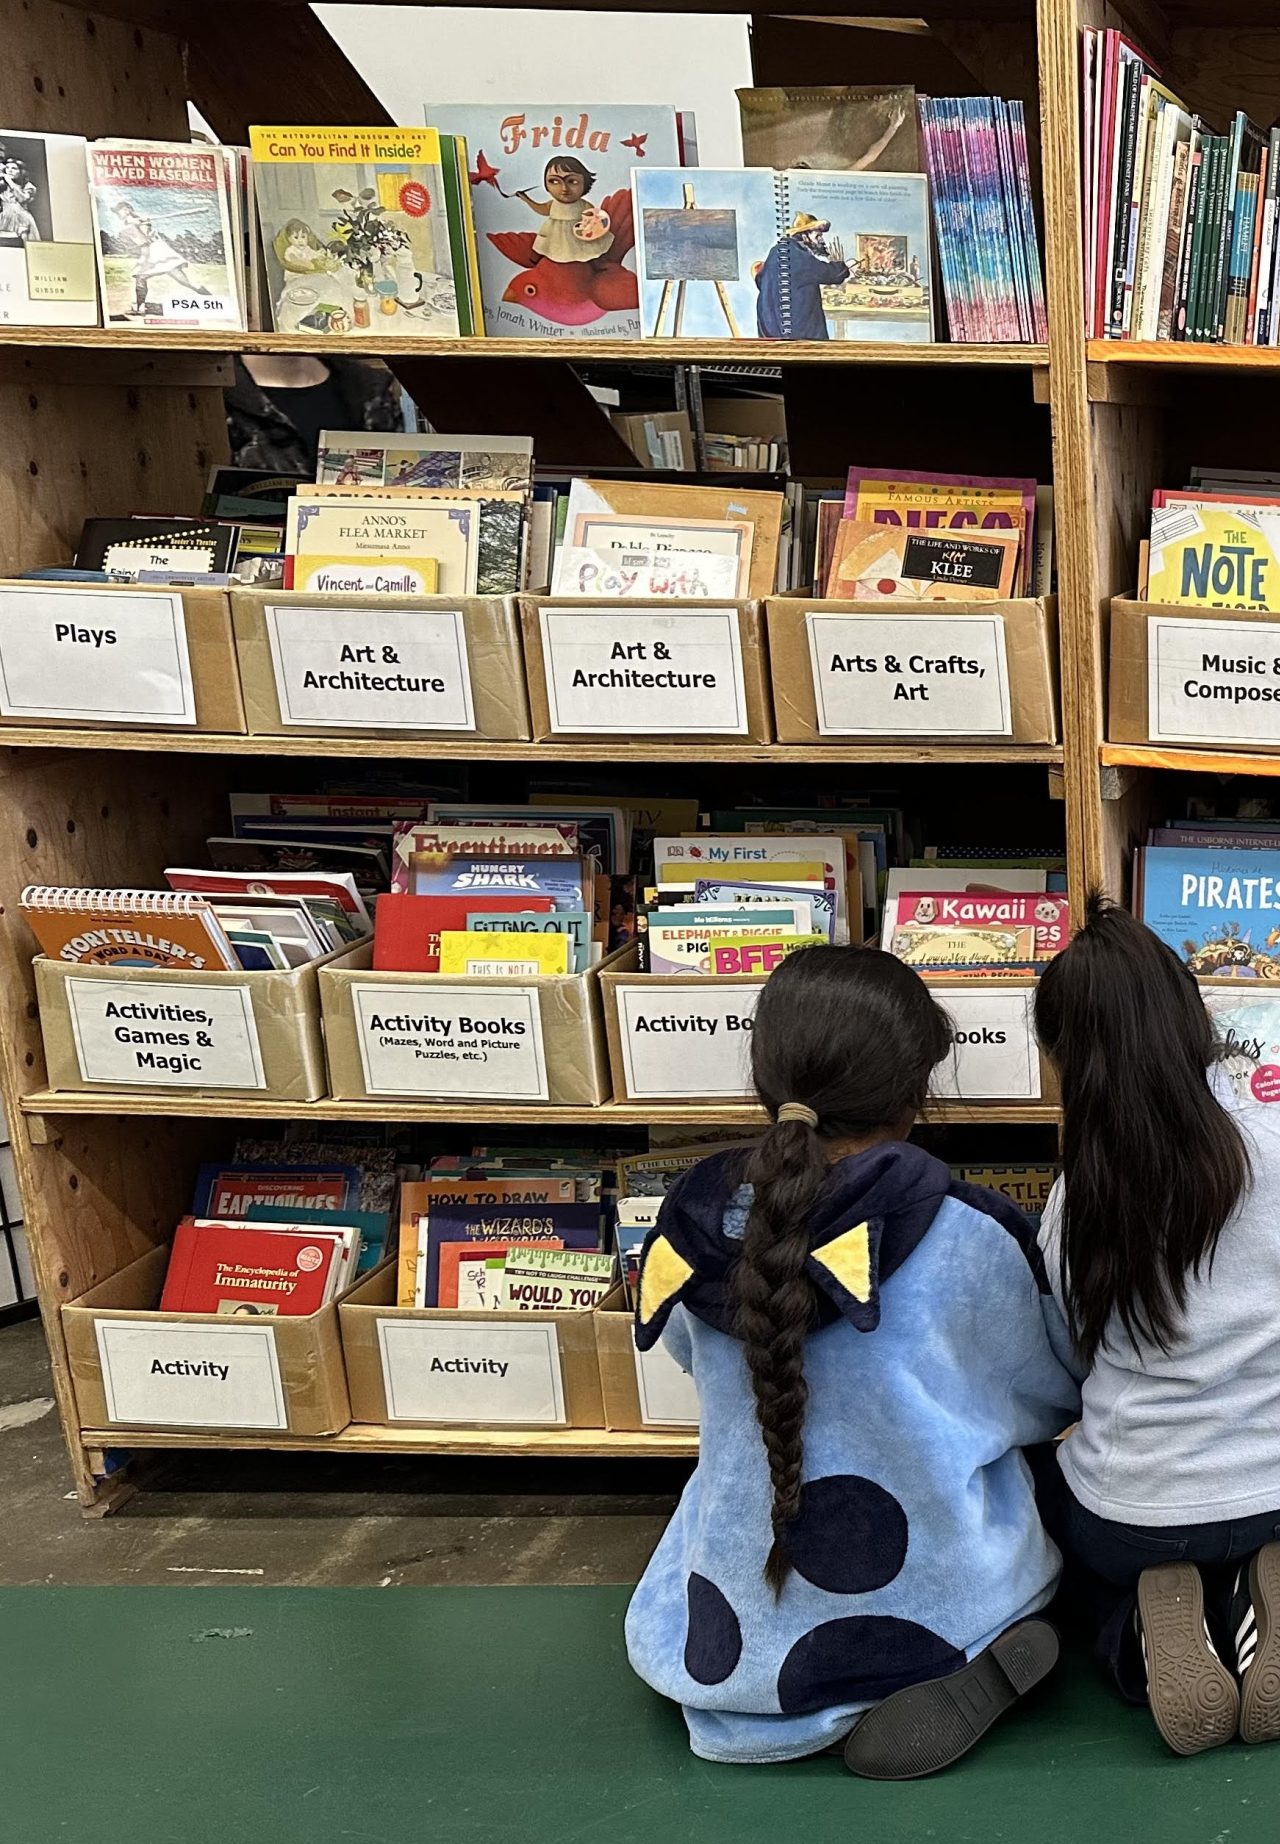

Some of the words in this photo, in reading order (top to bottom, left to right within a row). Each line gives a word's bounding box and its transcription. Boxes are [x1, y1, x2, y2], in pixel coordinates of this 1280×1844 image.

[500, 113, 611, 154] Frida
[269, 143, 296, 157] Can
[300, 144, 324, 157] You
[329, 144, 357, 157] Find
[361, 144, 370, 157] It
[375, 144, 421, 158] Inside?
[95, 155, 145, 167] WHEN
[149, 157, 212, 169] WOMEN
[96, 167, 145, 179] PLAYED
[149, 169, 214, 182] BASEBALL
[1240, 216, 1250, 253] HAMLET
[172, 299, 199, 309] PSA
[204, 300, 223, 310] 5th
[888, 492, 938, 504] FAMOUS
[945, 496, 994, 506] ARTISTS
[361, 515, 407, 526] ANNO'S
[339, 528, 370, 538] FLEA
[375, 529, 428, 539] MARKET
[1224, 530, 1247, 544] THE
[928, 540, 942, 548] LIFE
[944, 542, 961, 550] AND
[962, 544, 989, 554] WORKS
[150, 555, 169, 565] The
[930, 561, 973, 578] KLEE
[1180, 543, 1268, 602] NOTE
[317, 575, 364, 591] Vincent
[375, 575, 416, 593] Camille
[55, 624, 118, 645] Plays
[339, 645, 376, 665] Art
[381, 645, 401, 665] &
[610, 642, 647, 660] Art
[654, 641, 672, 660] &
[830, 654, 877, 673] Arts
[884, 655, 903, 673] &
[908, 655, 986, 678] Crafts,
[1202, 654, 1266, 675] Music
[303, 669, 446, 693] Architecture
[572, 669, 716, 688] Architecture
[894, 683, 929, 701] Art
[709, 847, 729, 862] My
[734, 847, 767, 860] First
[470, 864, 525, 874] HUNGRY
[452, 872, 541, 890] SHARK
[942, 899, 1026, 920] Kawaii
[59, 928, 206, 969] STORYTELLER'S
[715, 944, 784, 974] BFF
[105, 1002, 214, 1026] Activities,
[370, 1014, 452, 1036] Activity
[459, 1017, 526, 1035] Books
[635, 1015, 718, 1035] Activity
[115, 1028, 190, 1046] Games
[196, 1031, 214, 1048] &
[379, 1036, 421, 1048] (Mazes,
[425, 1038, 454, 1047] Word
[457, 1039, 478, 1048] and
[480, 1040, 520, 1049] Picture
[136, 1052, 202, 1074] Magic
[415, 1050, 460, 1062] Puzzles,
[462, 1051, 488, 1062] etc.)
[216, 1264, 233, 1273] The
[234, 1264, 288, 1278] Encyclopedia
[289, 1269, 299, 1277] of
[213, 1273, 297, 1296] Immaturity
[509, 1284, 564, 1303] WOULD
[569, 1287, 602, 1306] YOU
[151, 1359, 230, 1381] Activity
[430, 1357, 509, 1377] Activity
